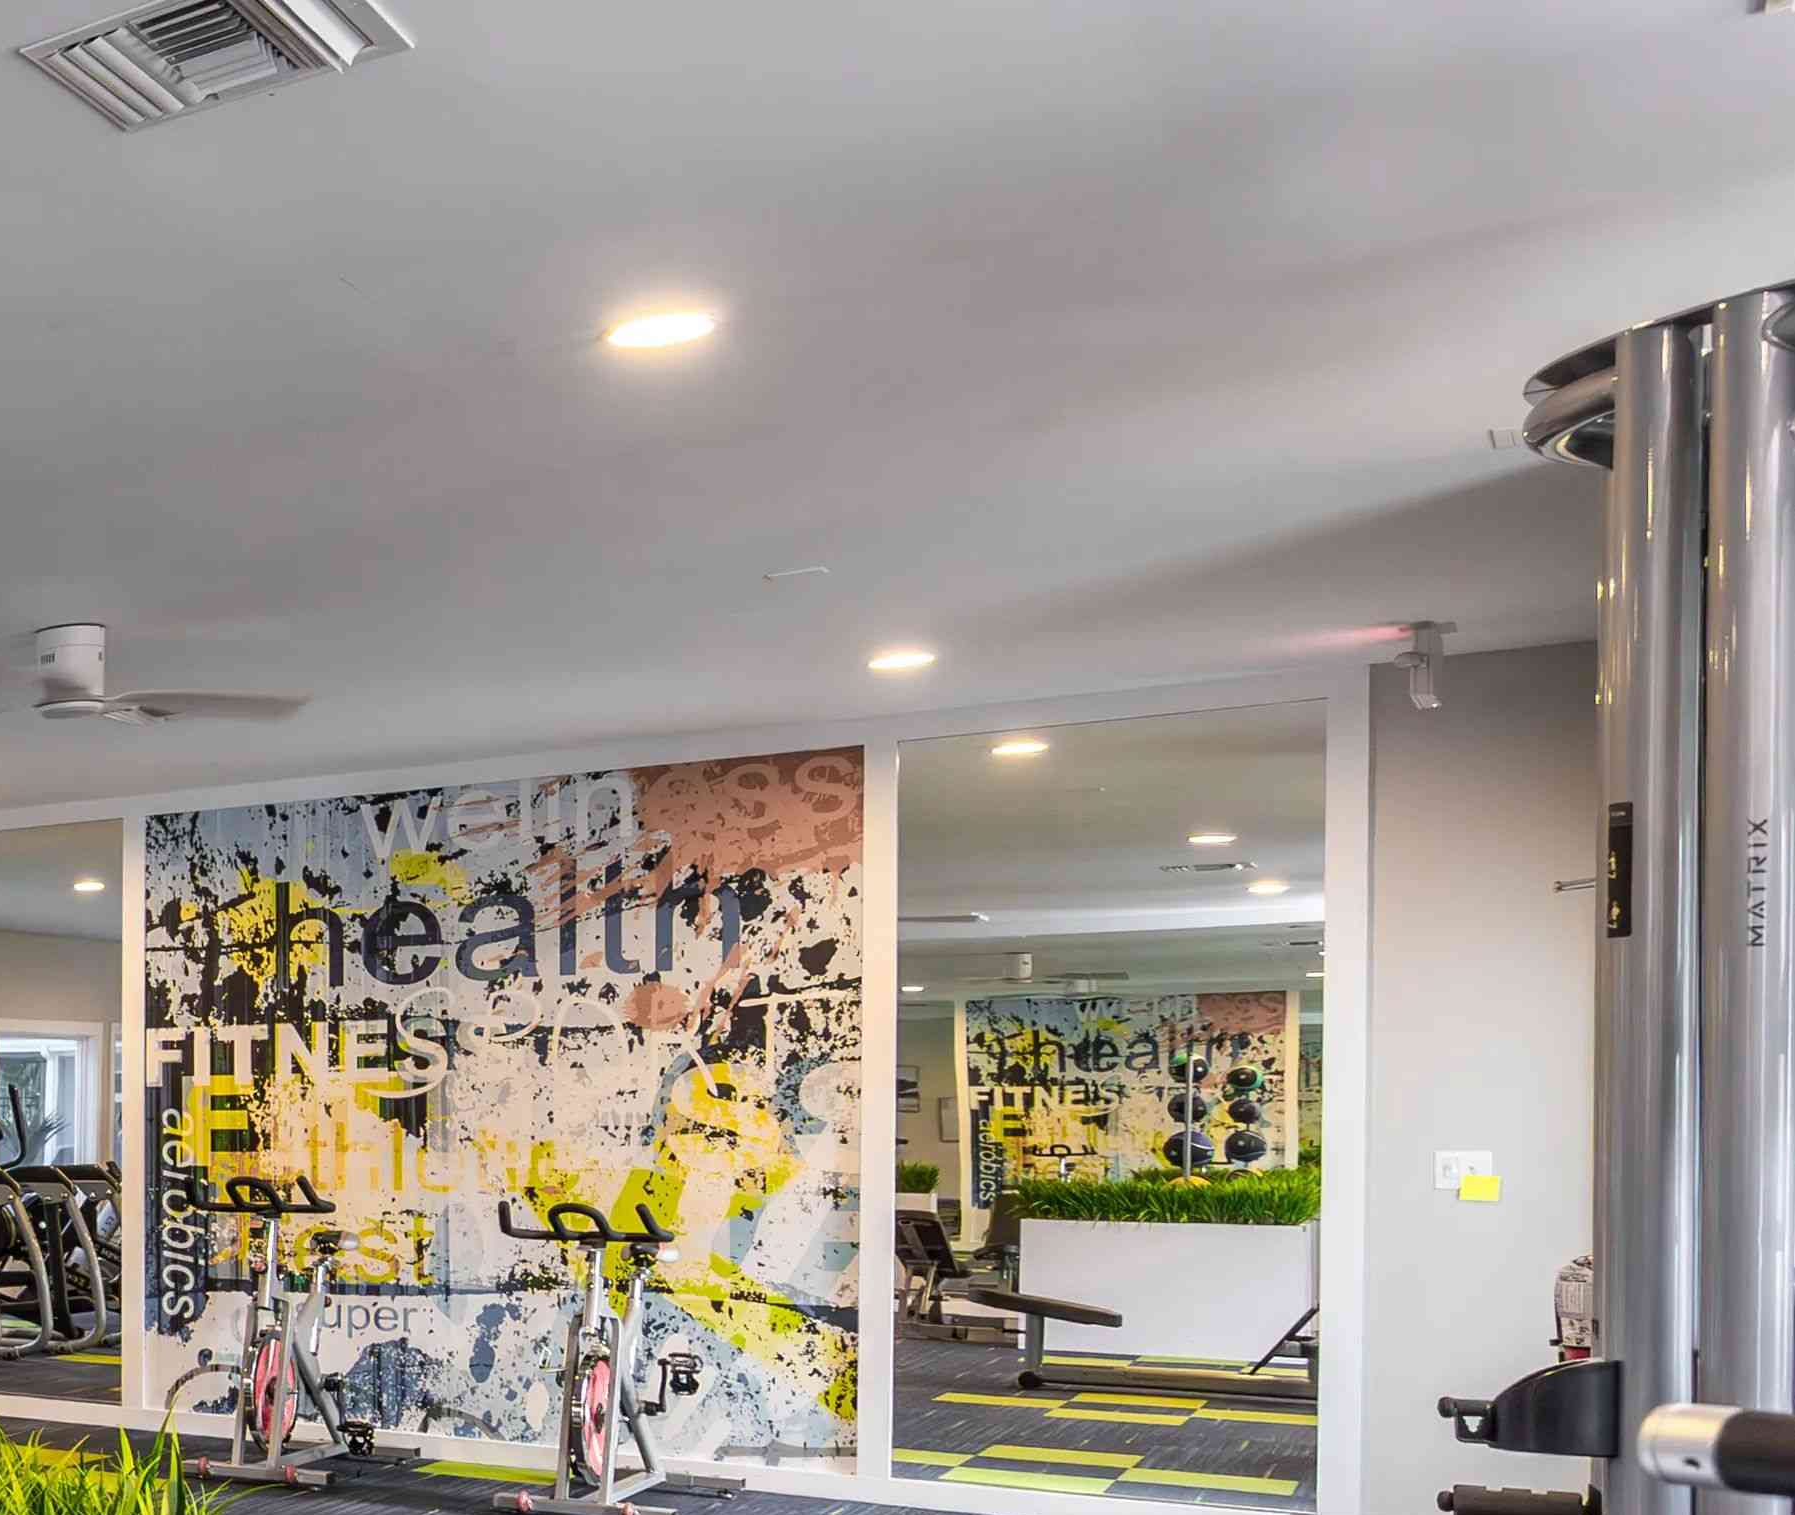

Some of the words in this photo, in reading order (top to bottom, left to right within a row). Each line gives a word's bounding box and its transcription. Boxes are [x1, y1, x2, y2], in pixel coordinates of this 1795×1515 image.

[275, 857, 741, 991] health
[1747, 819, 1768, 946] MATRIX
[161, 1107, 205, 1319] aerobics
[320, 1300, 419, 1339] uper
